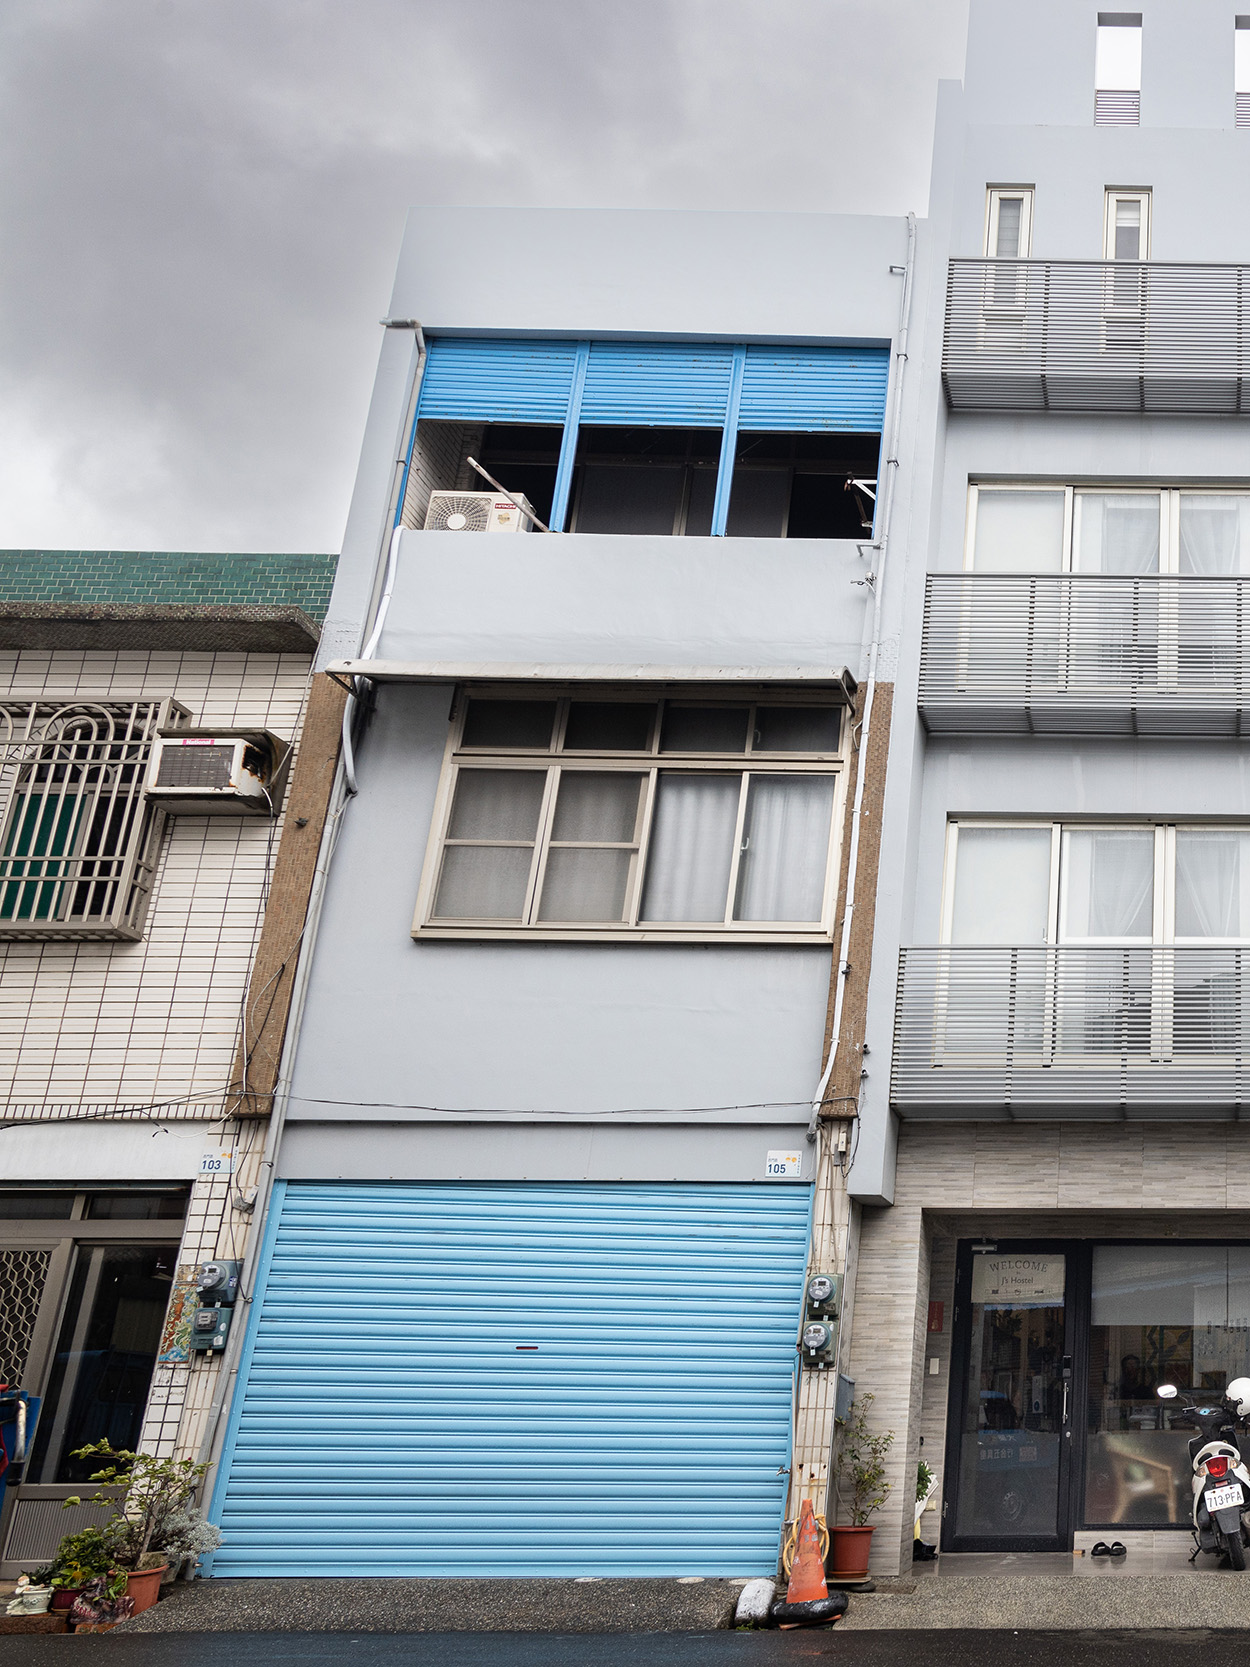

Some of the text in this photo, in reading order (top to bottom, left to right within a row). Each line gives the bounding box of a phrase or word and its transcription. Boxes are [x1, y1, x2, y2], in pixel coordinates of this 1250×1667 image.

[202, 1160, 221, 1170] 103
[768, 1163, 786, 1174] 105
[989, 1260, 1049, 1273] WELCOME
[1001, 1276, 1034, 1286] J's Hostel
